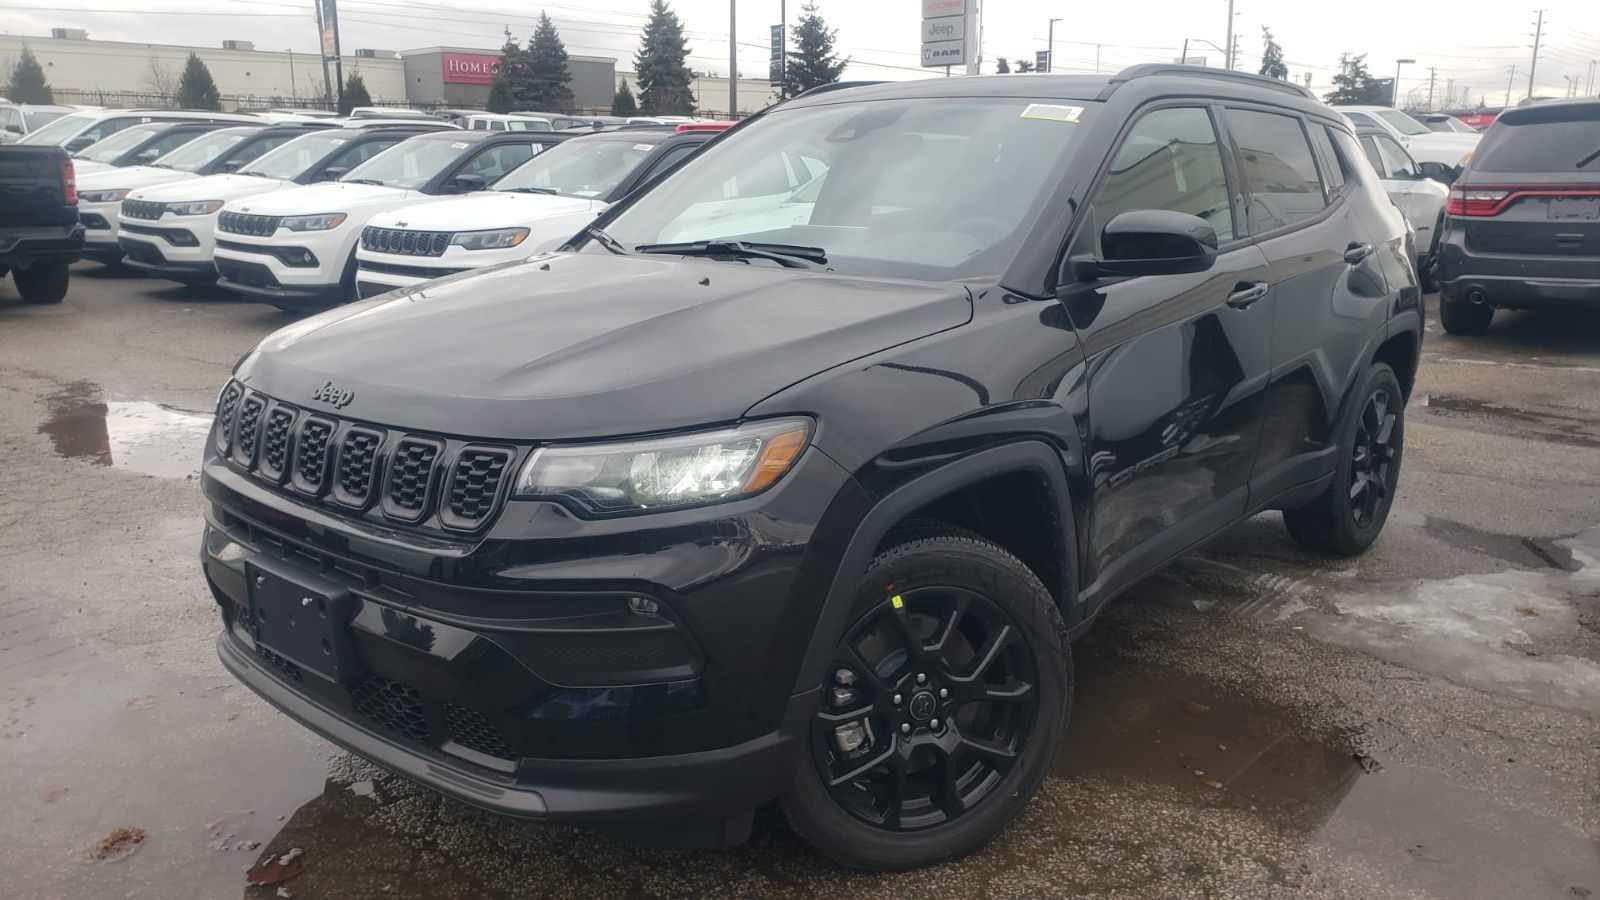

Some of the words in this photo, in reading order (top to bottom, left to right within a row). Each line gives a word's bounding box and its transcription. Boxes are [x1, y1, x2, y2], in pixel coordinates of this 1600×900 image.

[928, 23, 954, 37] Jeep
[932, 48, 960, 57] RAM
[312, 381, 355, 409] Jeep
